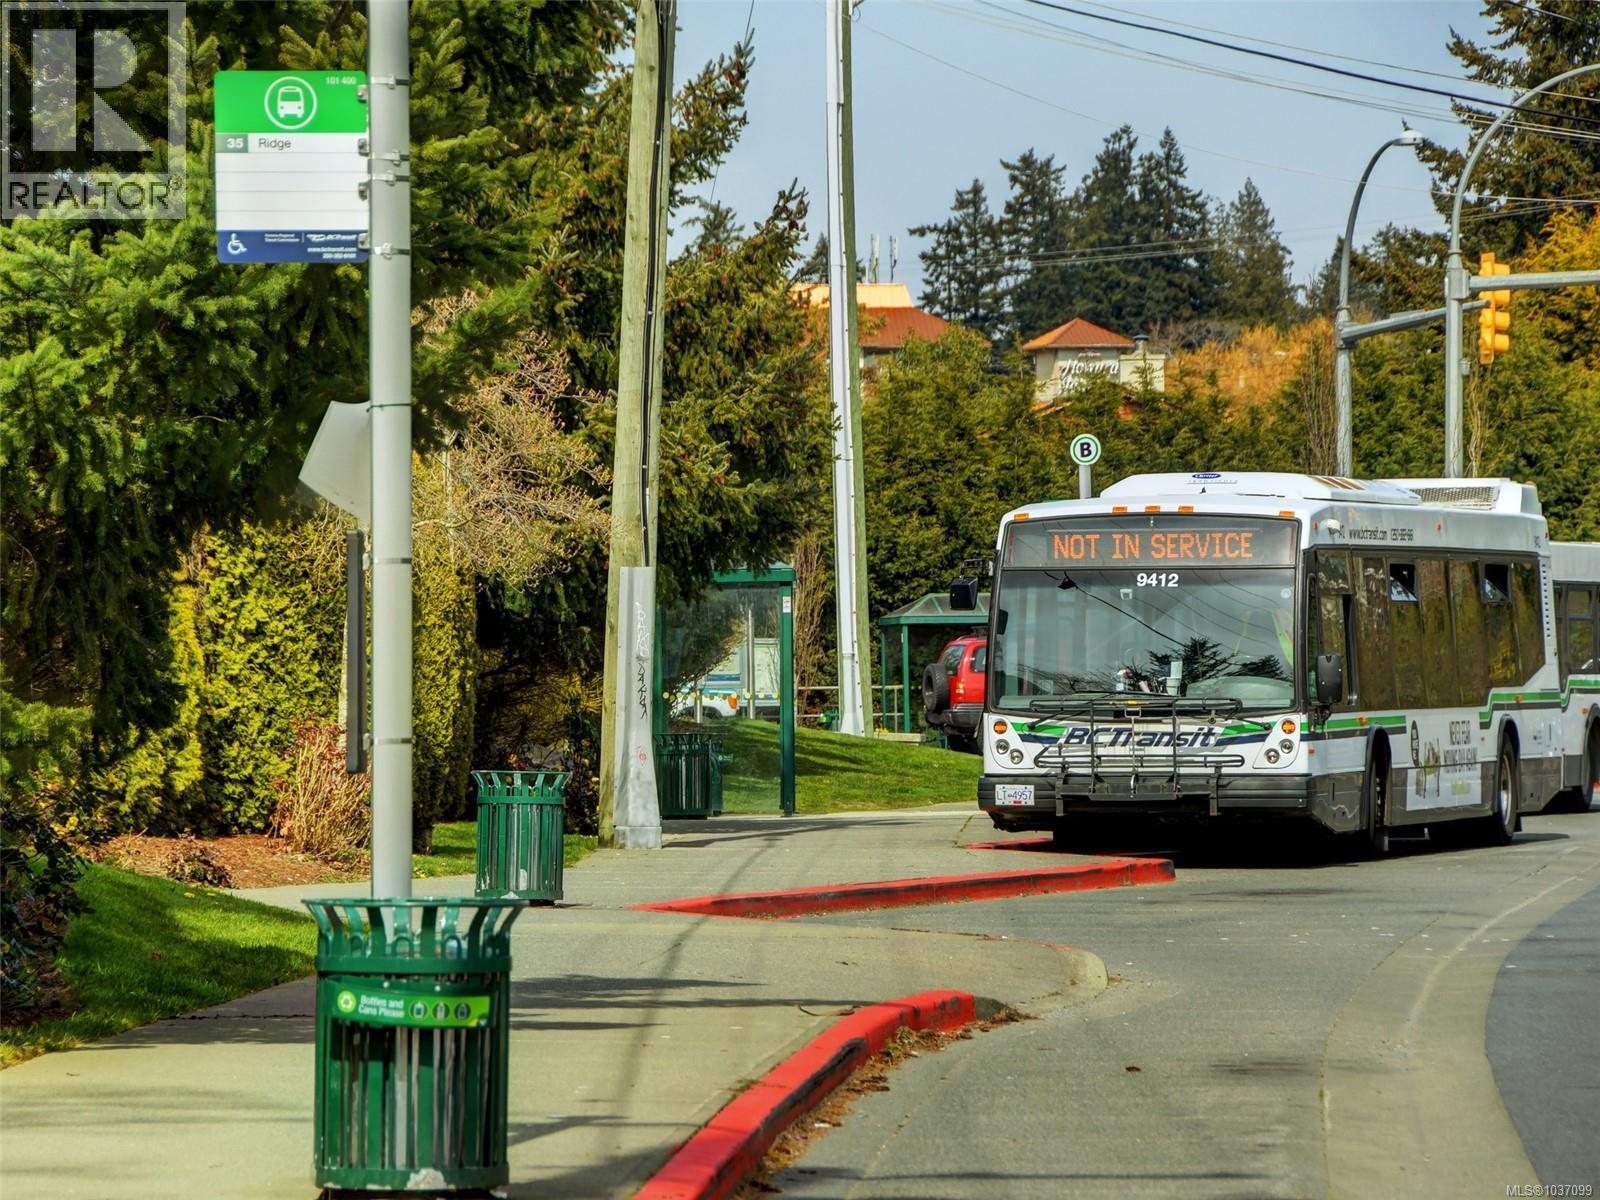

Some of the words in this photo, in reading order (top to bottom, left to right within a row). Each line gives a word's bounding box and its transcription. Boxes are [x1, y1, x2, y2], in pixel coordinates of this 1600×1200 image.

[227, 138, 243, 148] 35
[259, 138, 291, 150] Ridge
[1079, 442, 1092, 457] B
[1053, 533, 1100, 559] NOT
[1112, 533, 1140, 559] IN
[1151, 533, 1253, 559] SERVICE
[1136, 573, 1179, 587] 9412
[1065, 727, 1216, 747] BCTransit
[361, 995, 386, 1006] Bottles
[389, 999, 404, 1008] and
[359, 1004, 377, 1015] Cans
[379, 1007, 405, 1018] Please
